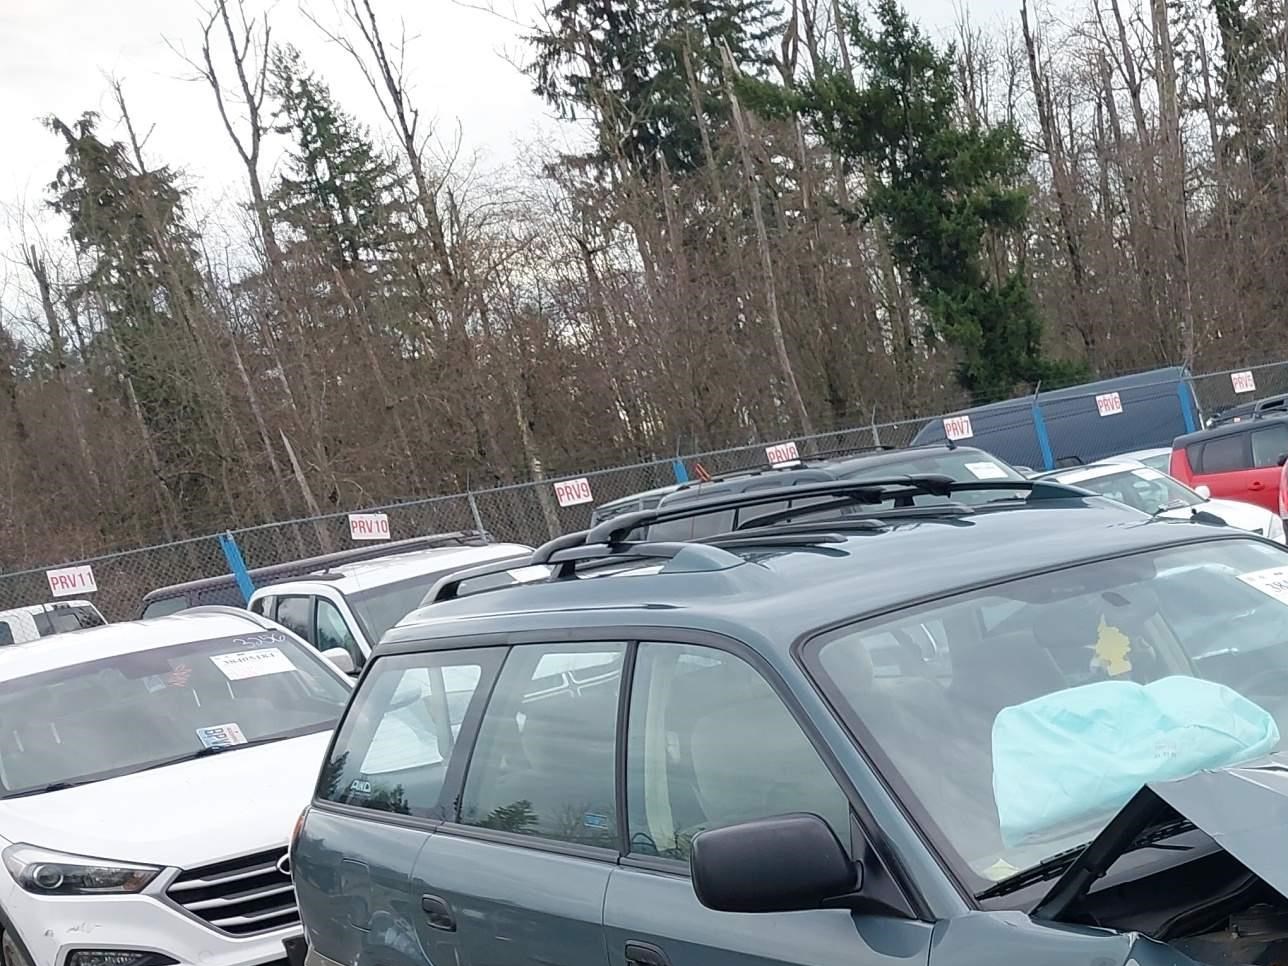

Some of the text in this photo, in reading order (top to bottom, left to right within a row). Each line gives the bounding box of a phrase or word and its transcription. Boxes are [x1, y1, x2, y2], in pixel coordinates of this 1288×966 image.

[556, 482, 590, 503] PRV9
[351, 520, 388, 533] PRV10
[50, 571, 94, 591] PRV11
